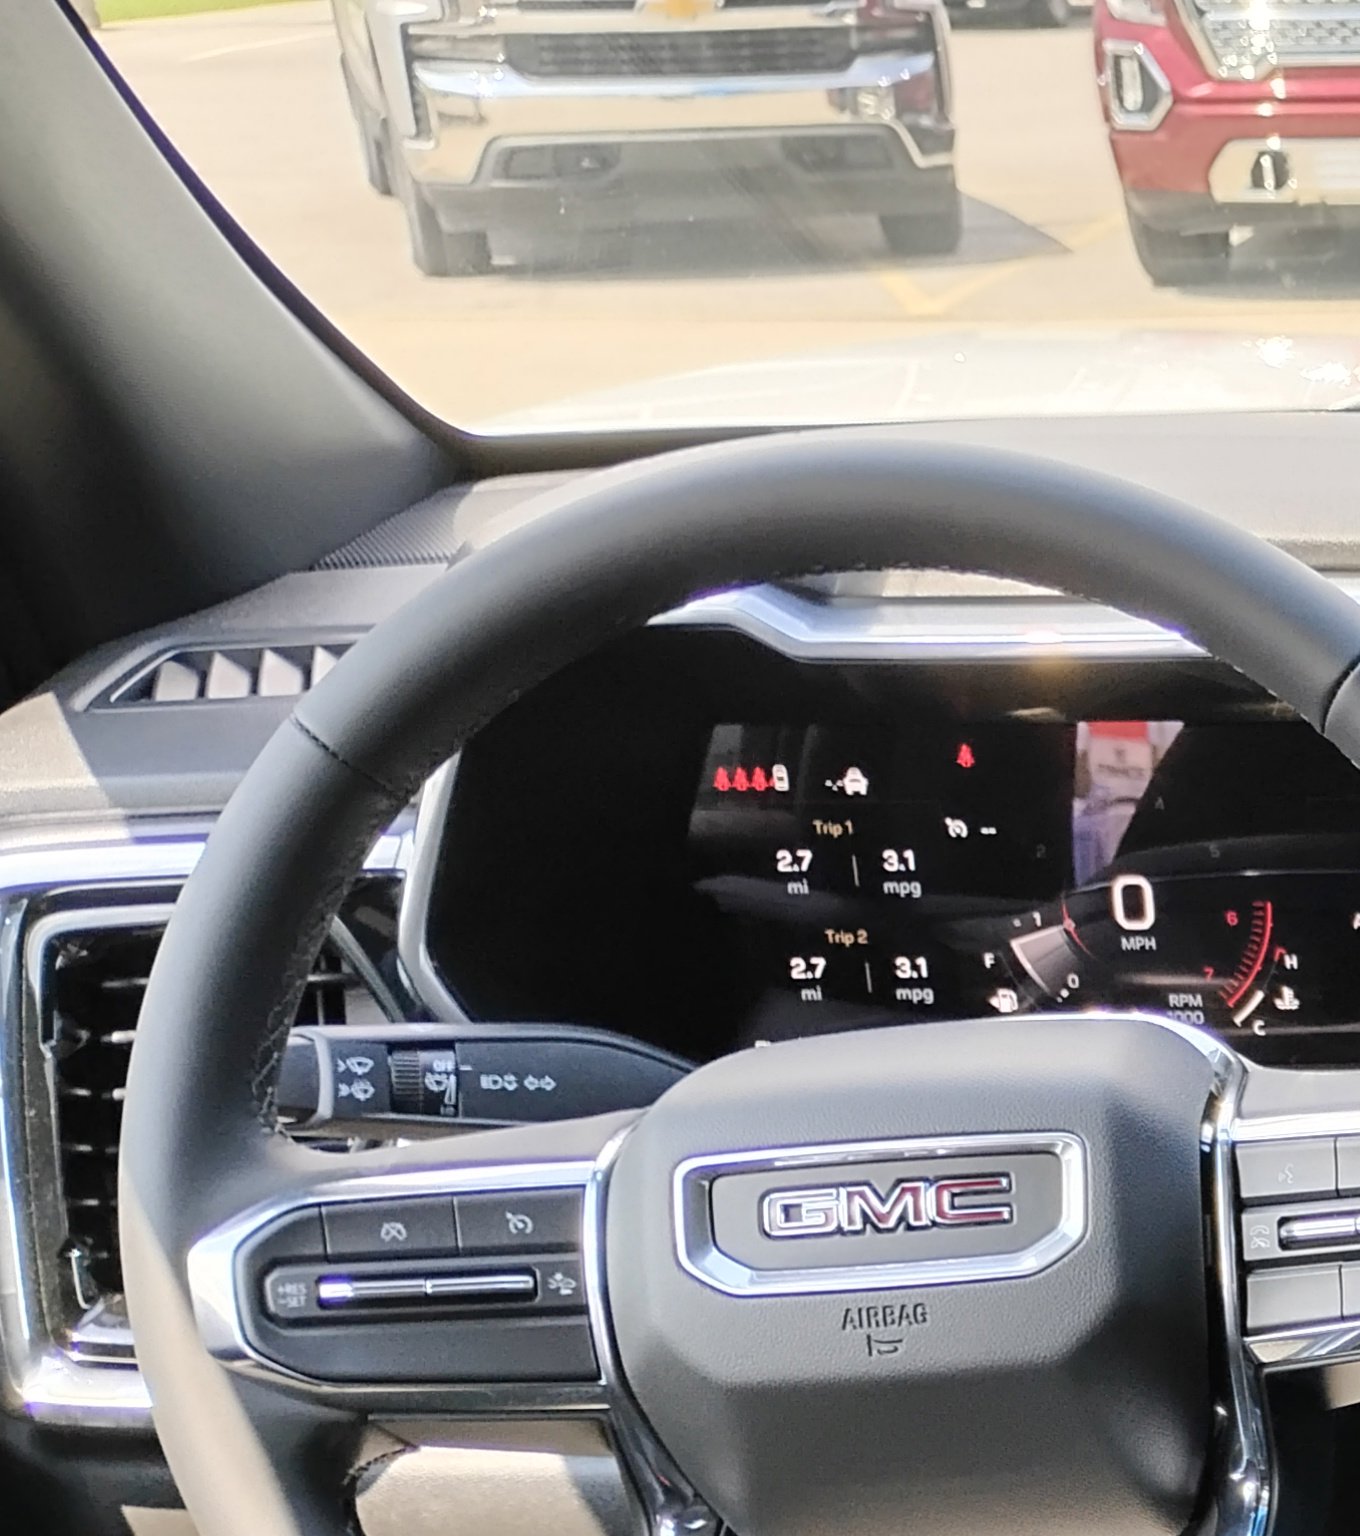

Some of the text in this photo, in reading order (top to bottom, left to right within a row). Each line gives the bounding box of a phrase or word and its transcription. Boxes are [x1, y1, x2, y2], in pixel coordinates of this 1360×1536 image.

[812, 819, 853, 839] Trip 1
[775, 849, 813, 873] 2.7
[881, 848, 916, 872] 3.1
[787, 878, 810, 895] mi
[883, 880, 922, 898] mpg
[1110, 874, 1156, 931] 0
[1032, 911, 1042, 927] 1
[1225, 911, 1239, 926] 6
[824, 928, 868, 948] Trip 2
[1120, 936, 1157, 951] MPH
[789, 956, 827, 980] 2.7
[894, 955, 929, 979] 3.1
[983, 952, 996, 969] F
[1283, 954, 1299, 970] H
[1203, 966, 1215, 981] 7
[801, 985, 823, 1001] mi
[895, 986, 935, 1005] mpg
[1168, 993, 1204, 1008] RPM
[1252, 1019, 1266, 1036] C
[759, 1172, 1014, 1239] GMC
[841, 1302, 928, 1330] AIRBAG
